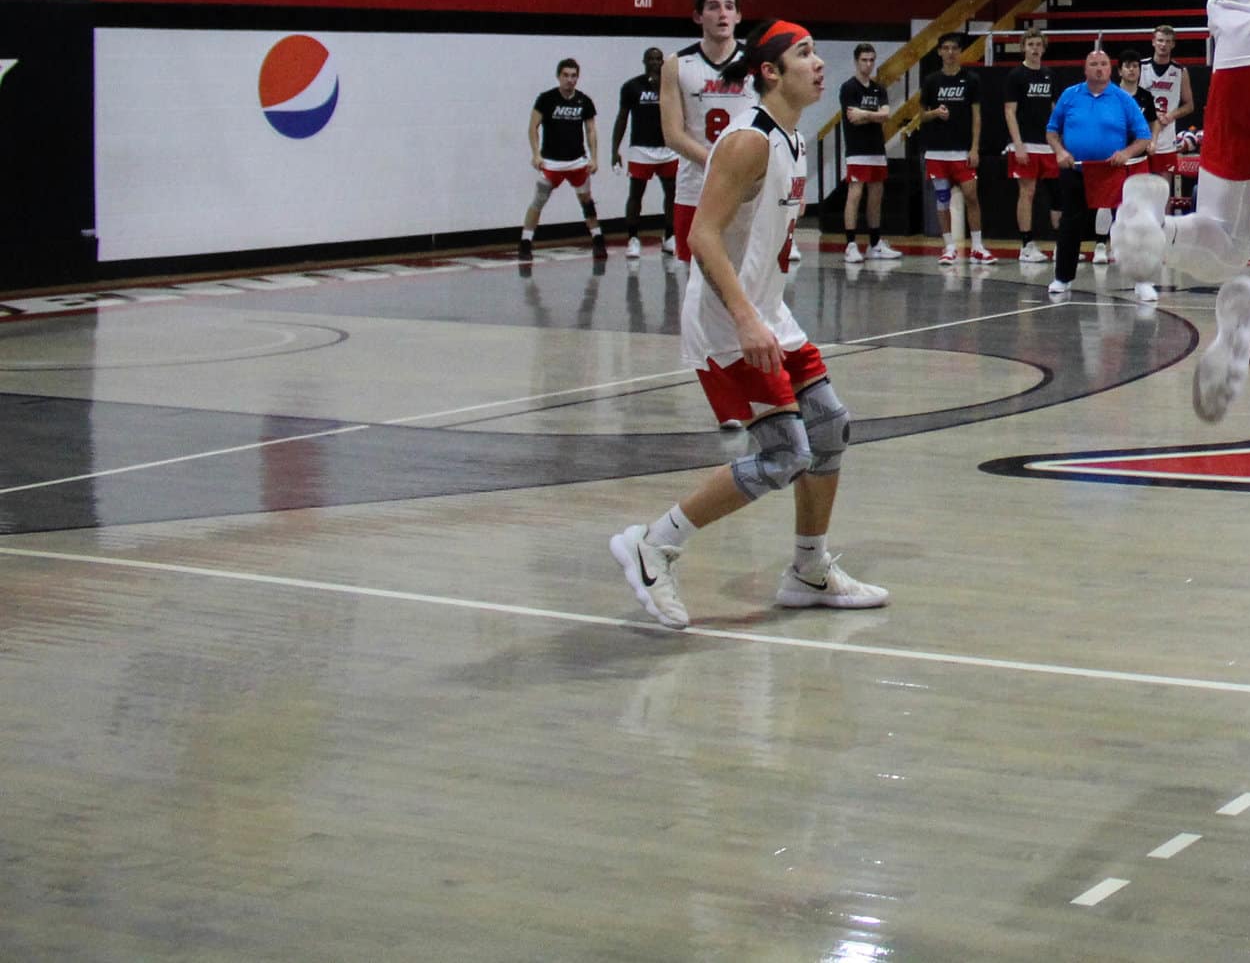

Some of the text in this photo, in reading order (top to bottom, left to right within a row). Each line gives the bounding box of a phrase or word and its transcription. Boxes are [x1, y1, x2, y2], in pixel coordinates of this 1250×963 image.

[937, 86, 965, 97] NGU
[1028, 83, 1050, 93] NGU
[553, 106, 583, 117] NGU
[705, 108, 730, 143] 8
